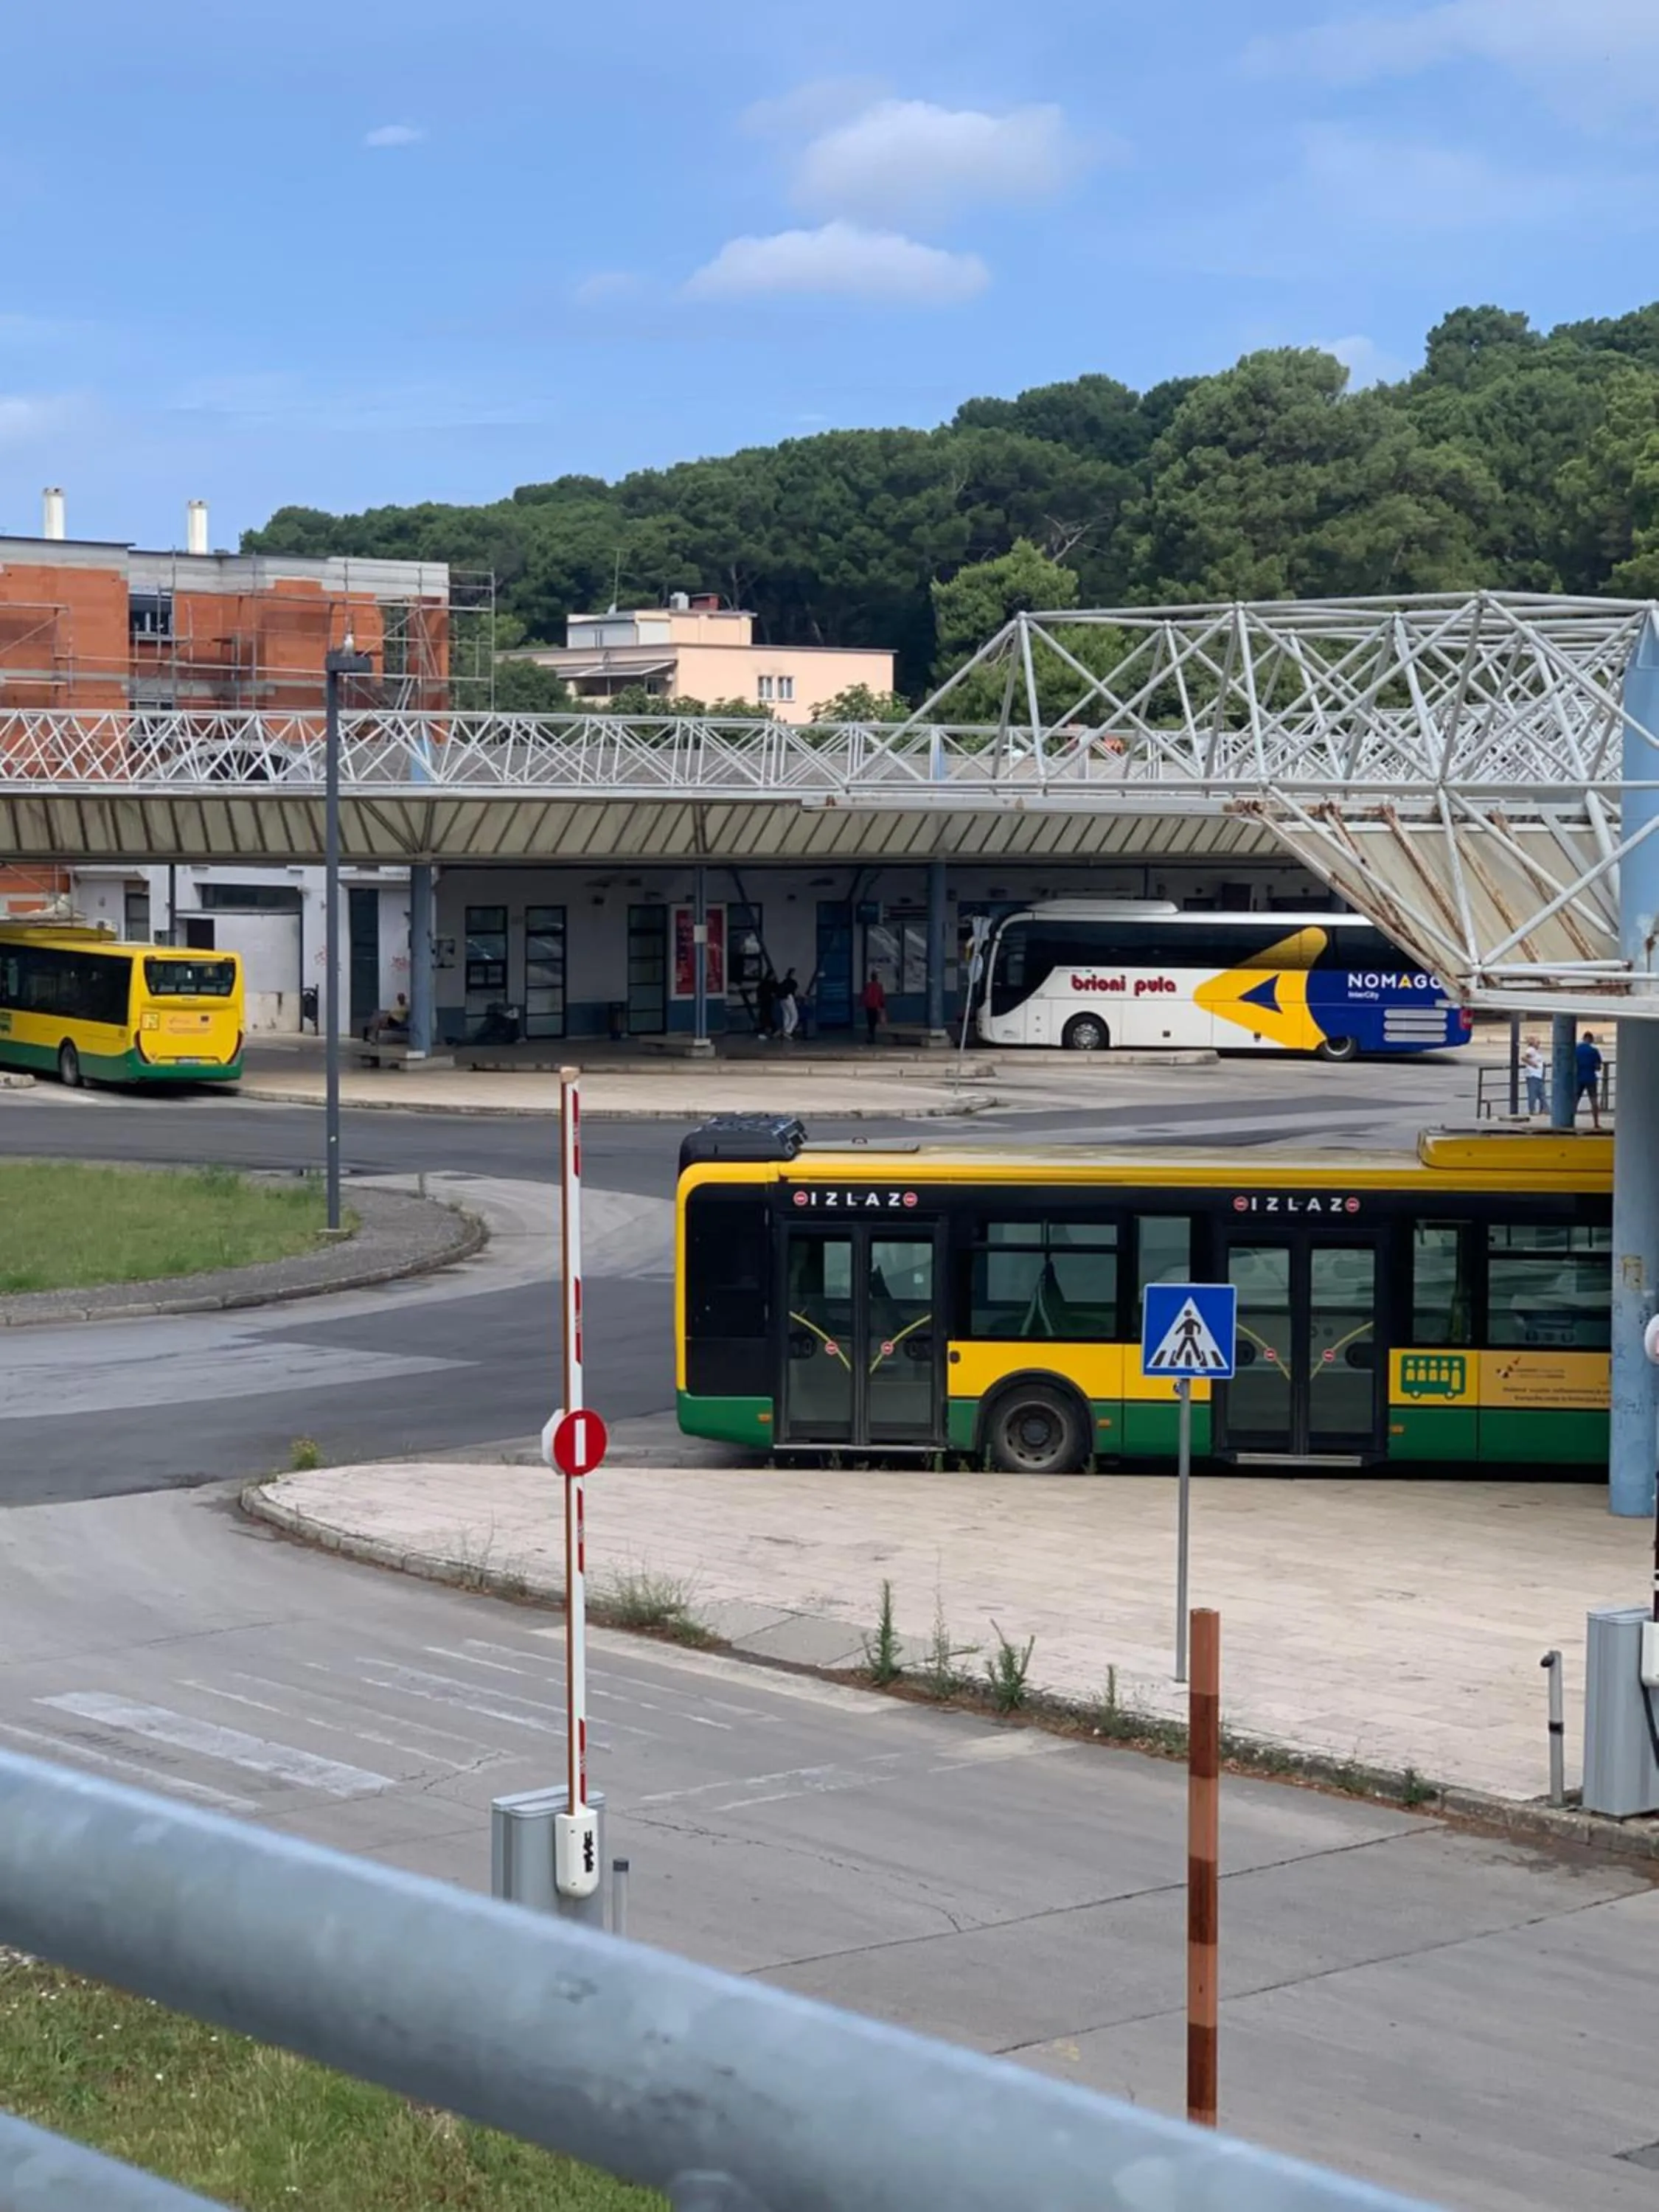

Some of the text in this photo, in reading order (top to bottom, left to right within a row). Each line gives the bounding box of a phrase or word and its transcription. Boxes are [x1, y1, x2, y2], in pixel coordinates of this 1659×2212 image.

[1071, 974, 1177, 997] brioni pula
[810, 1191, 901, 1206] IZLAZ
[1251, 1197, 1343, 1212] IZLAZ
